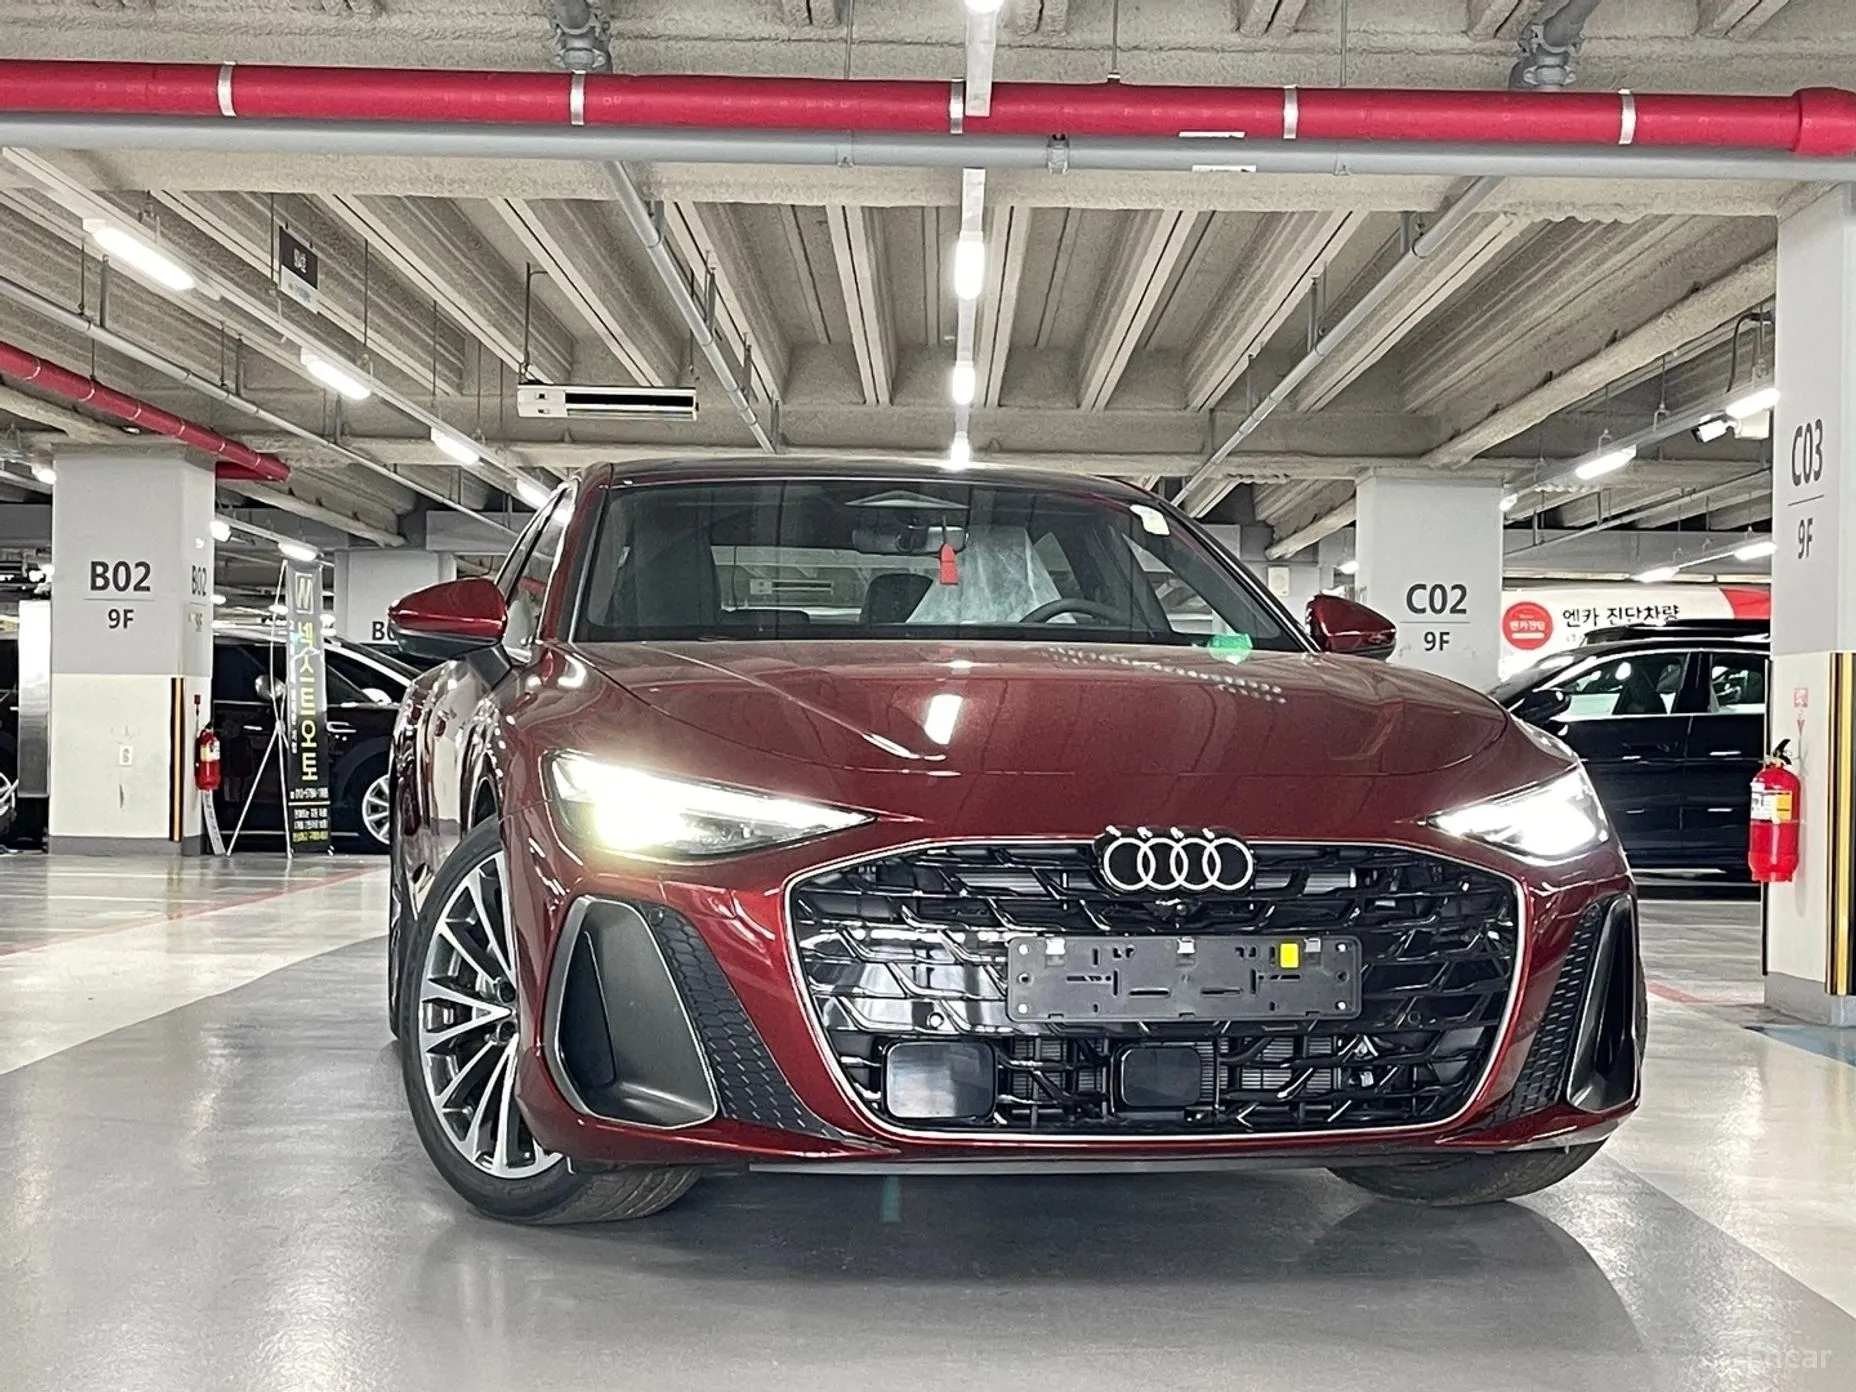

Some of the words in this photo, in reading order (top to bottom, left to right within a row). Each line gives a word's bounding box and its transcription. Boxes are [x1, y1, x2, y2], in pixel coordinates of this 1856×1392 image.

[1791, 418, 1823, 486] C03
[1798, 517, 1813, 559] 9F
[90, 560, 151, 592] B02
[191, 565, 207, 596] B02
[1406, 584, 1467, 614] C02
[108, 608, 134, 629] 9F
[1562, 607, 1600, 628] 엔카
[1606, 604, 1680, 626] 진단차량
[1423, 631, 1450, 652] 9F
